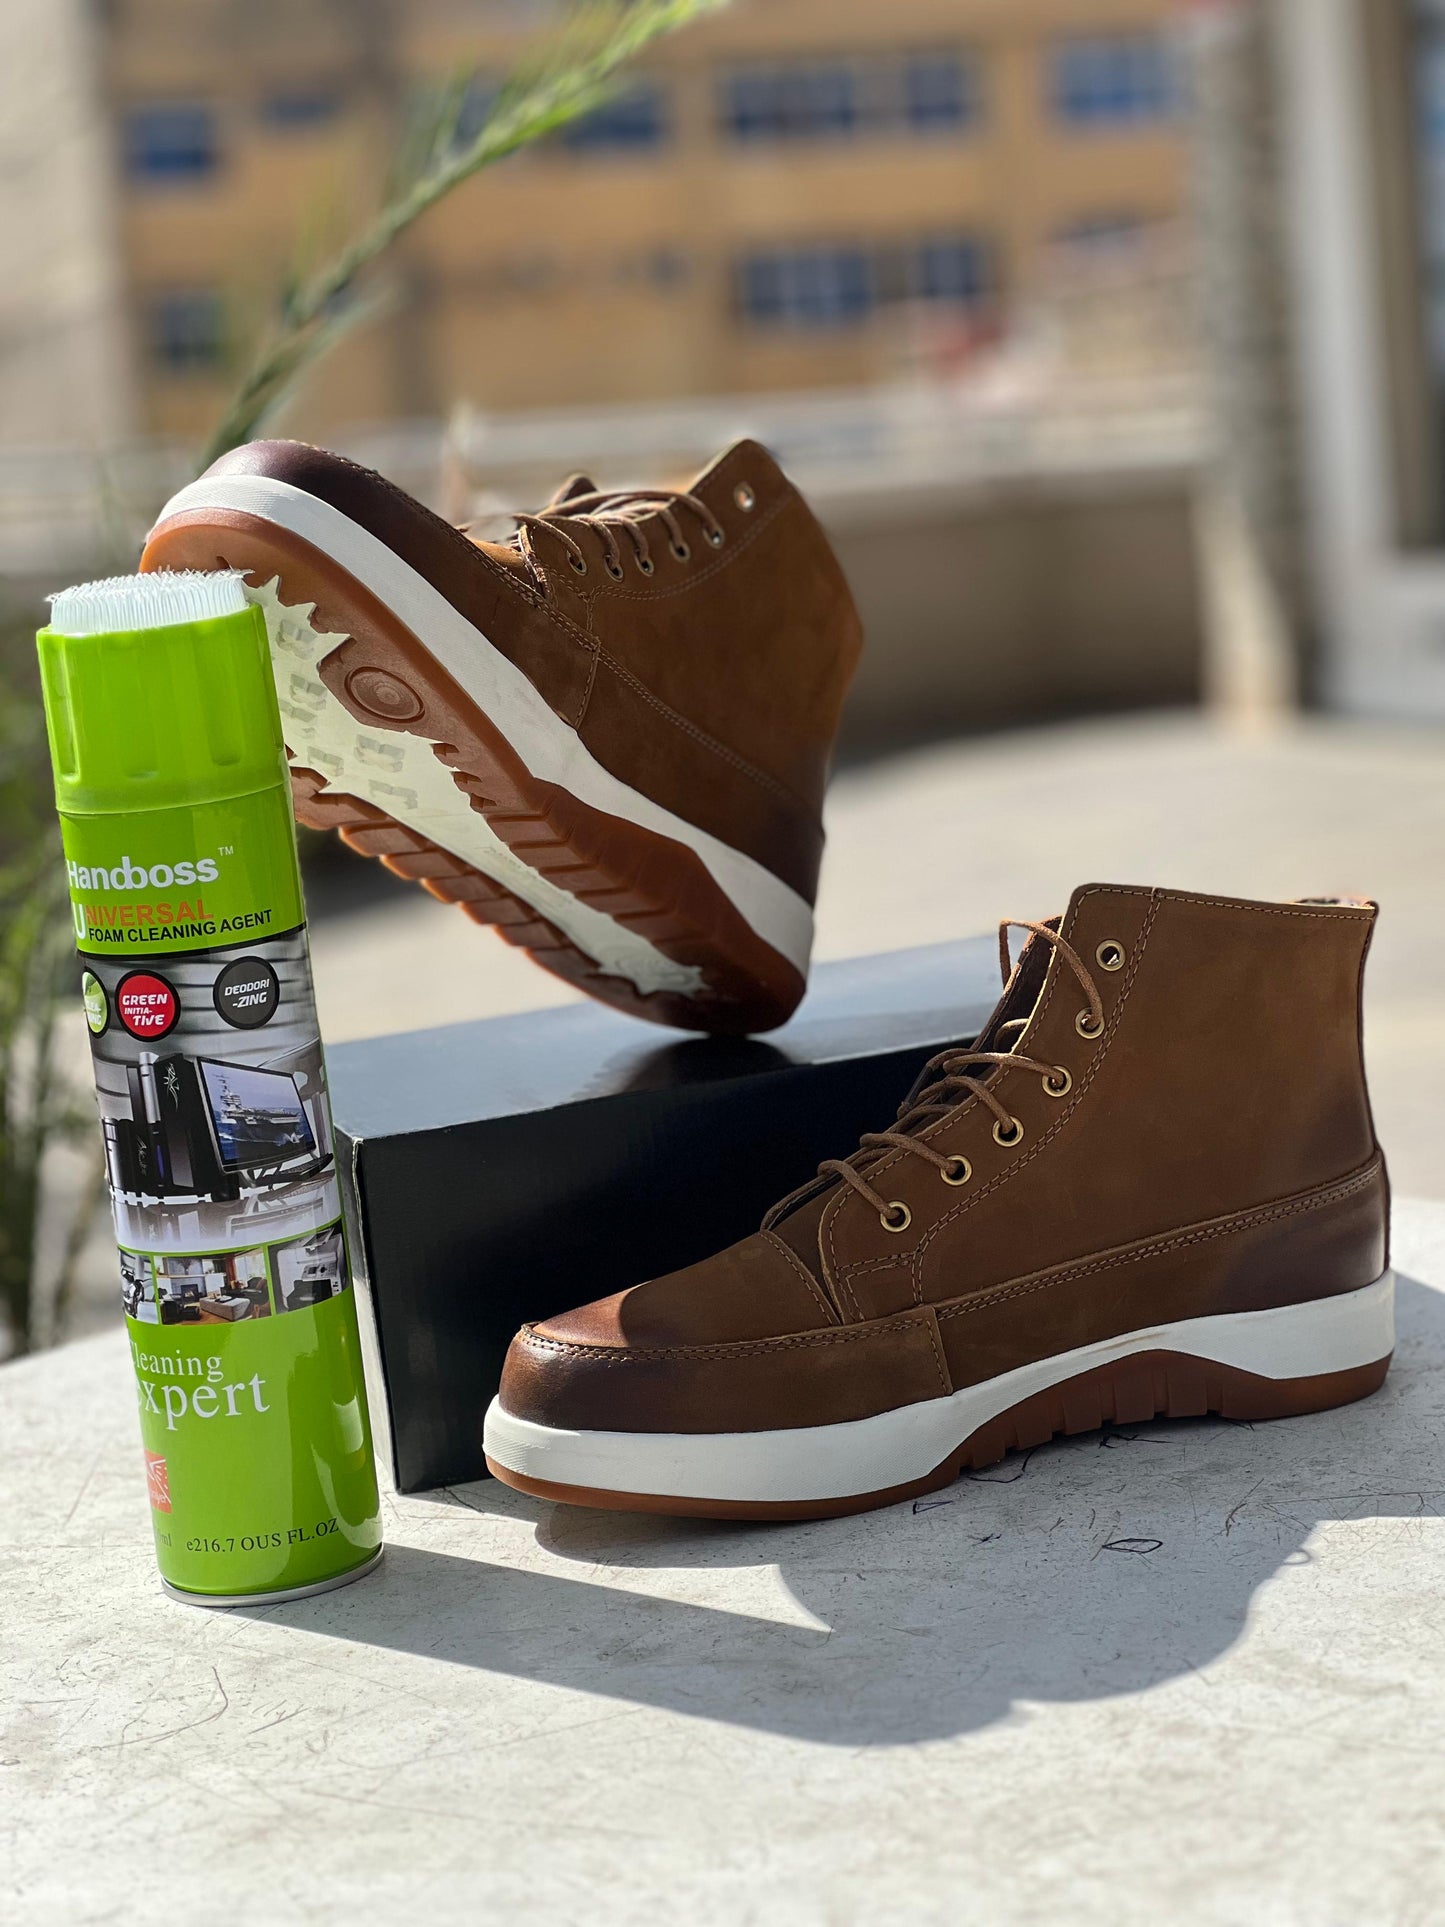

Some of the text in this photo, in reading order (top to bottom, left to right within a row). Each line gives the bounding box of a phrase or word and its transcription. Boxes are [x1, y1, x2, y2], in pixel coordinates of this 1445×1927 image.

[218, 845, 234, 856] TM
[66, 856, 219, 890] Handboss
[72, 899, 214, 940] UNIVERSAL
[89, 909, 273, 942] FOAM CLEANING AGENT
[224, 978, 270, 996] DEODORI
[122, 994, 168, 1006] GREEN
[232, 992, 267, 1008] -ZING
[124, 1007, 152, 1015] INITIA-
[133, 1014, 165, 1026] TIVE
[130, 1341, 224, 1382] leaning
[138, 1373, 270, 1431] xpert
[241, 1533, 281, 1551] OUS
